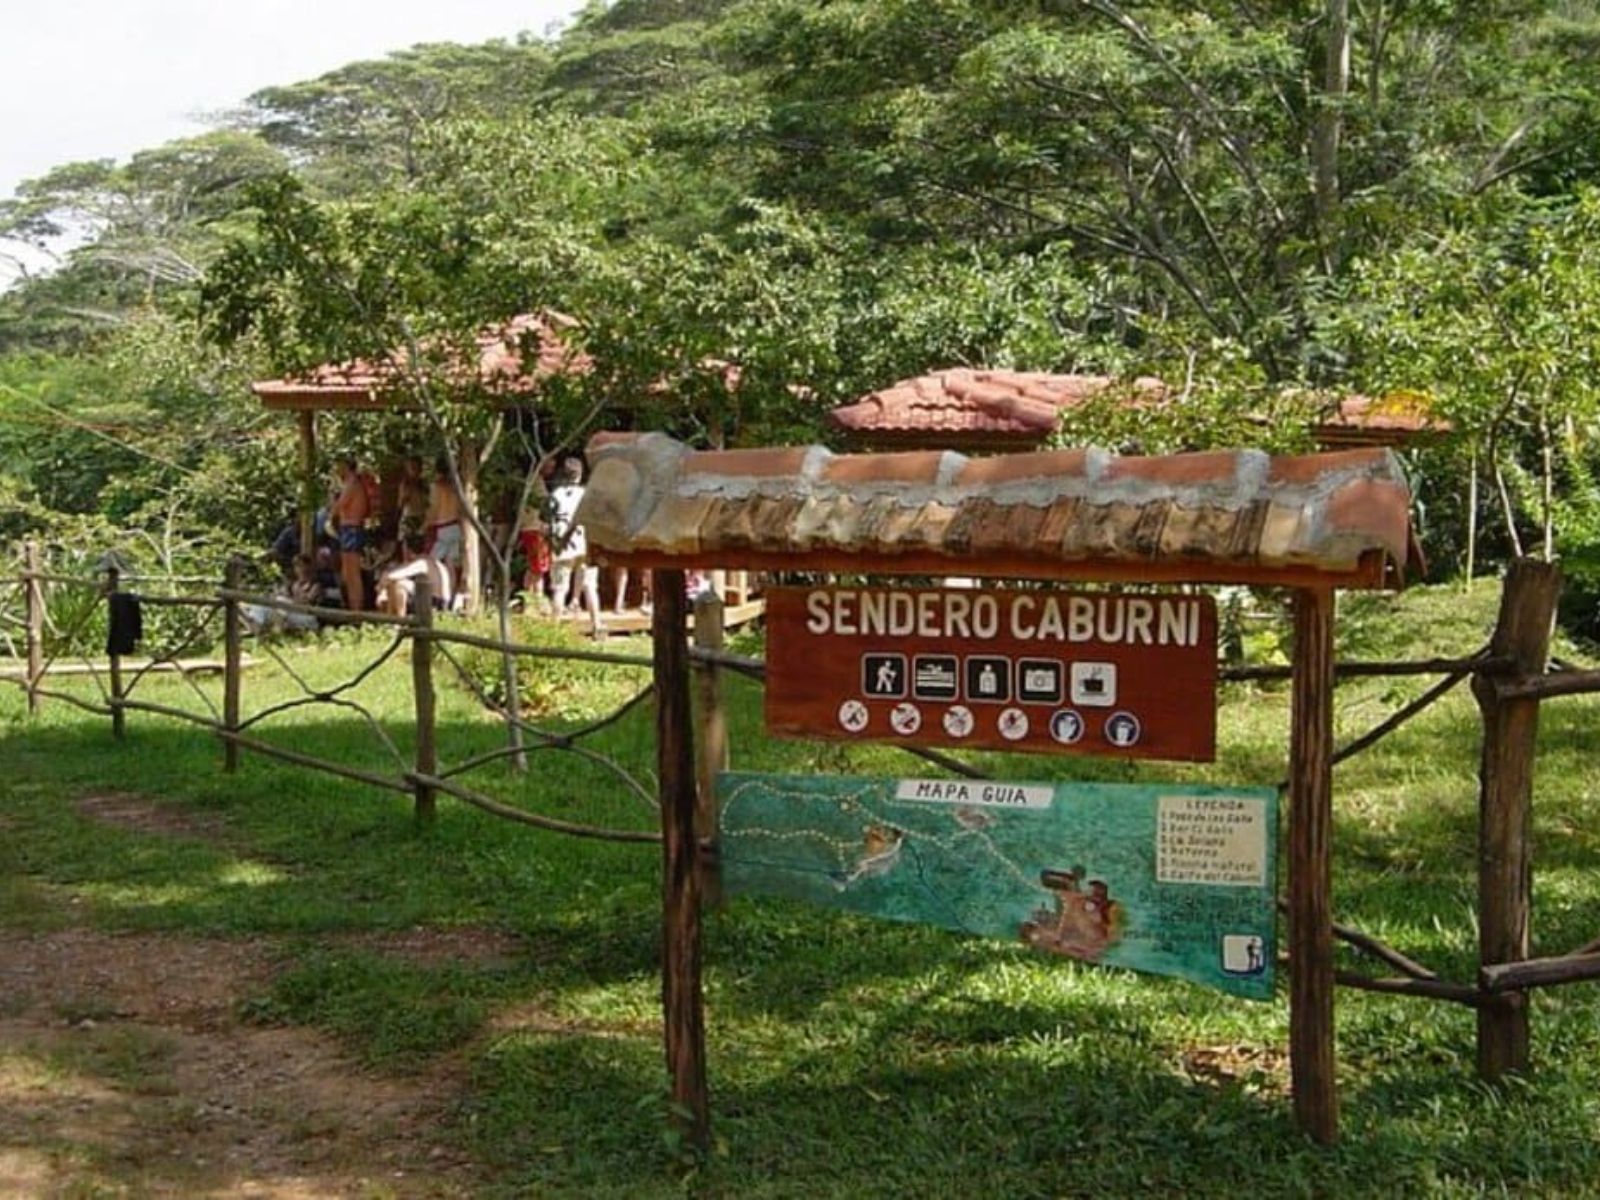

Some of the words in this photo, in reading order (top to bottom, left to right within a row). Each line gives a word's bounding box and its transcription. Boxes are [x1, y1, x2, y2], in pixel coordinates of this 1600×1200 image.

[806, 591, 998, 638] SENDERO
[1009, 594, 1200, 646] CABURNI
[915, 782, 970, 799] MAPA
[982, 786, 1027, 803] GUIA
